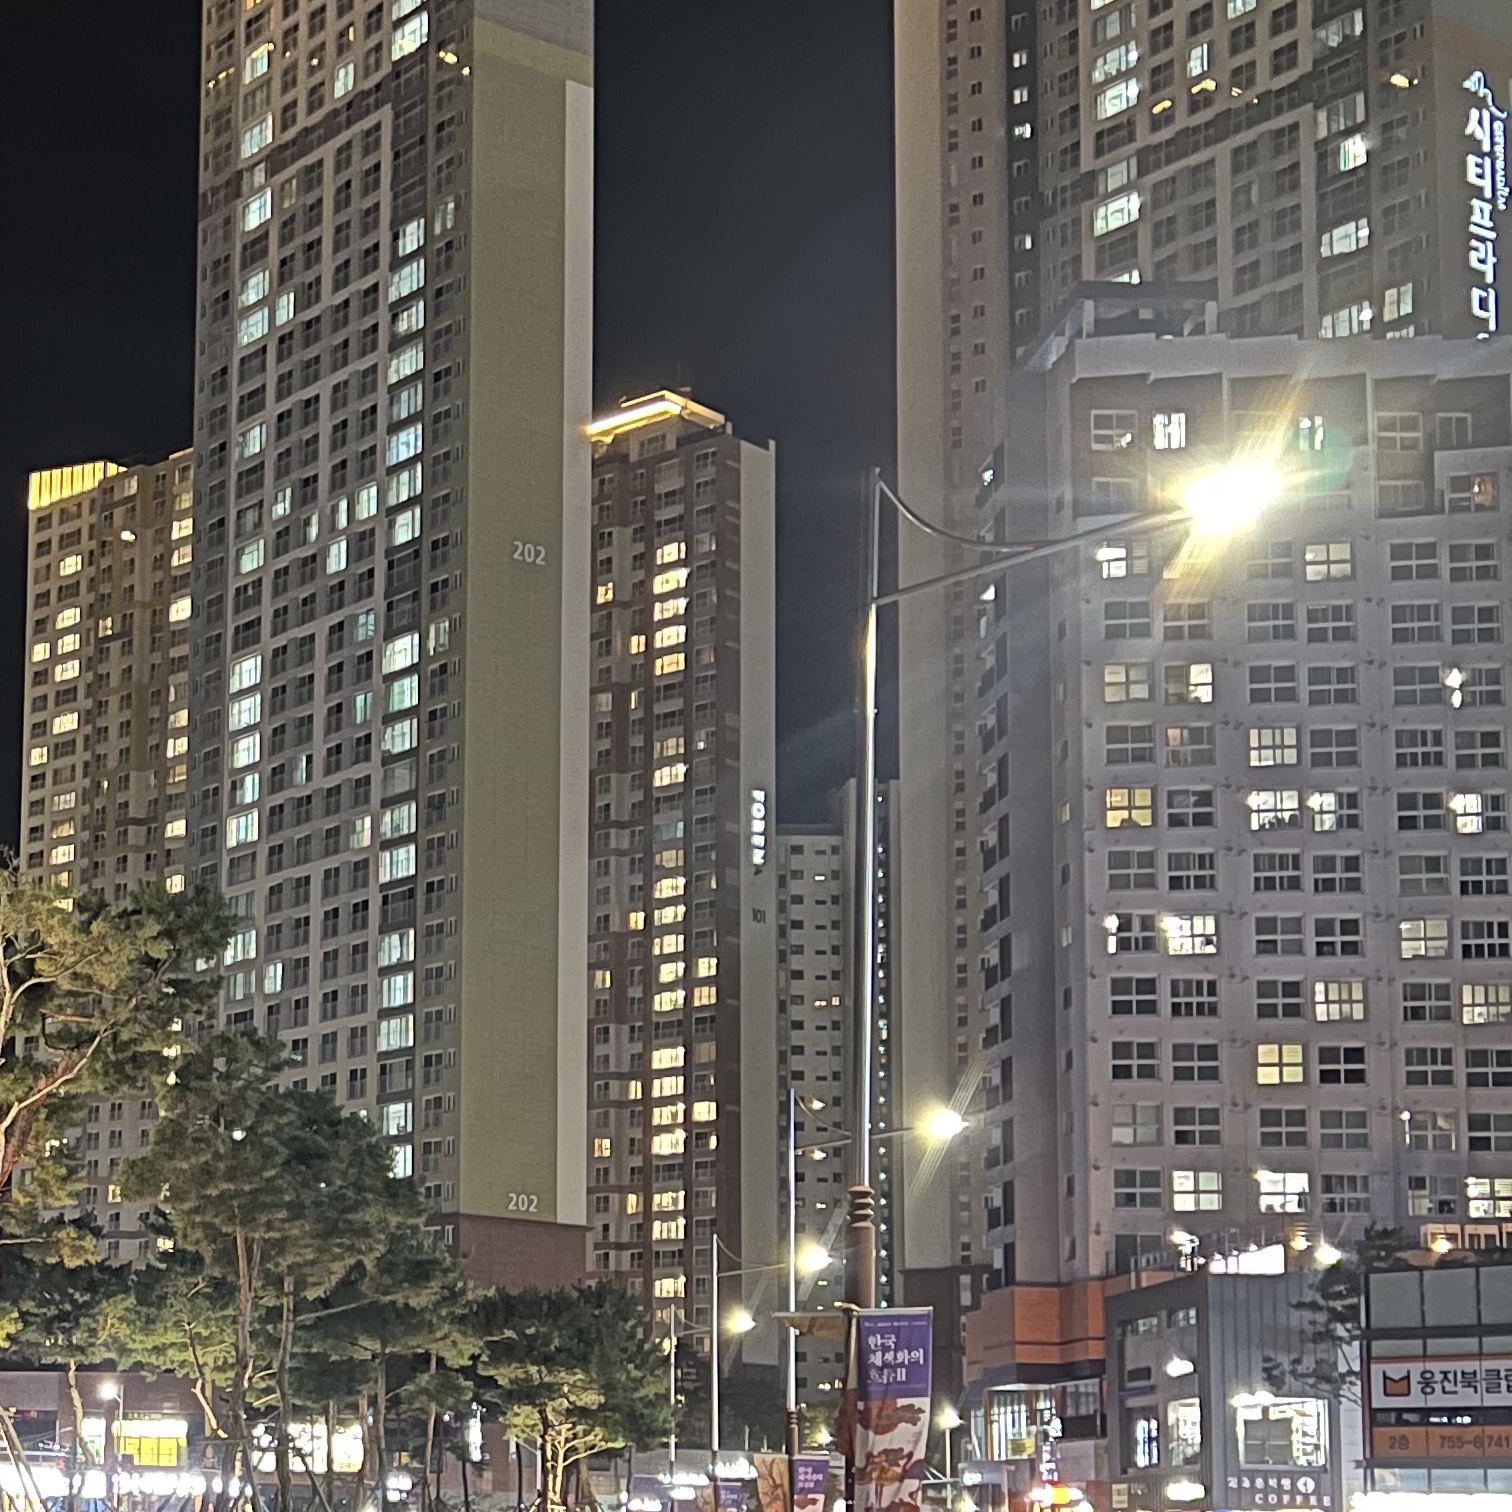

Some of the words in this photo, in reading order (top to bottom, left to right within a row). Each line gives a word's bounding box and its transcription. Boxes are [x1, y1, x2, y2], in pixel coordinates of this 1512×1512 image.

[1464, 107, 1498, 341] 시티프라디
[512, 541, 546, 565] 202
[507, 1193, 538, 1212] 202
[867, 1333, 897, 1351] 한국
[1254, 1493, 1331, 1507] COFFEE
